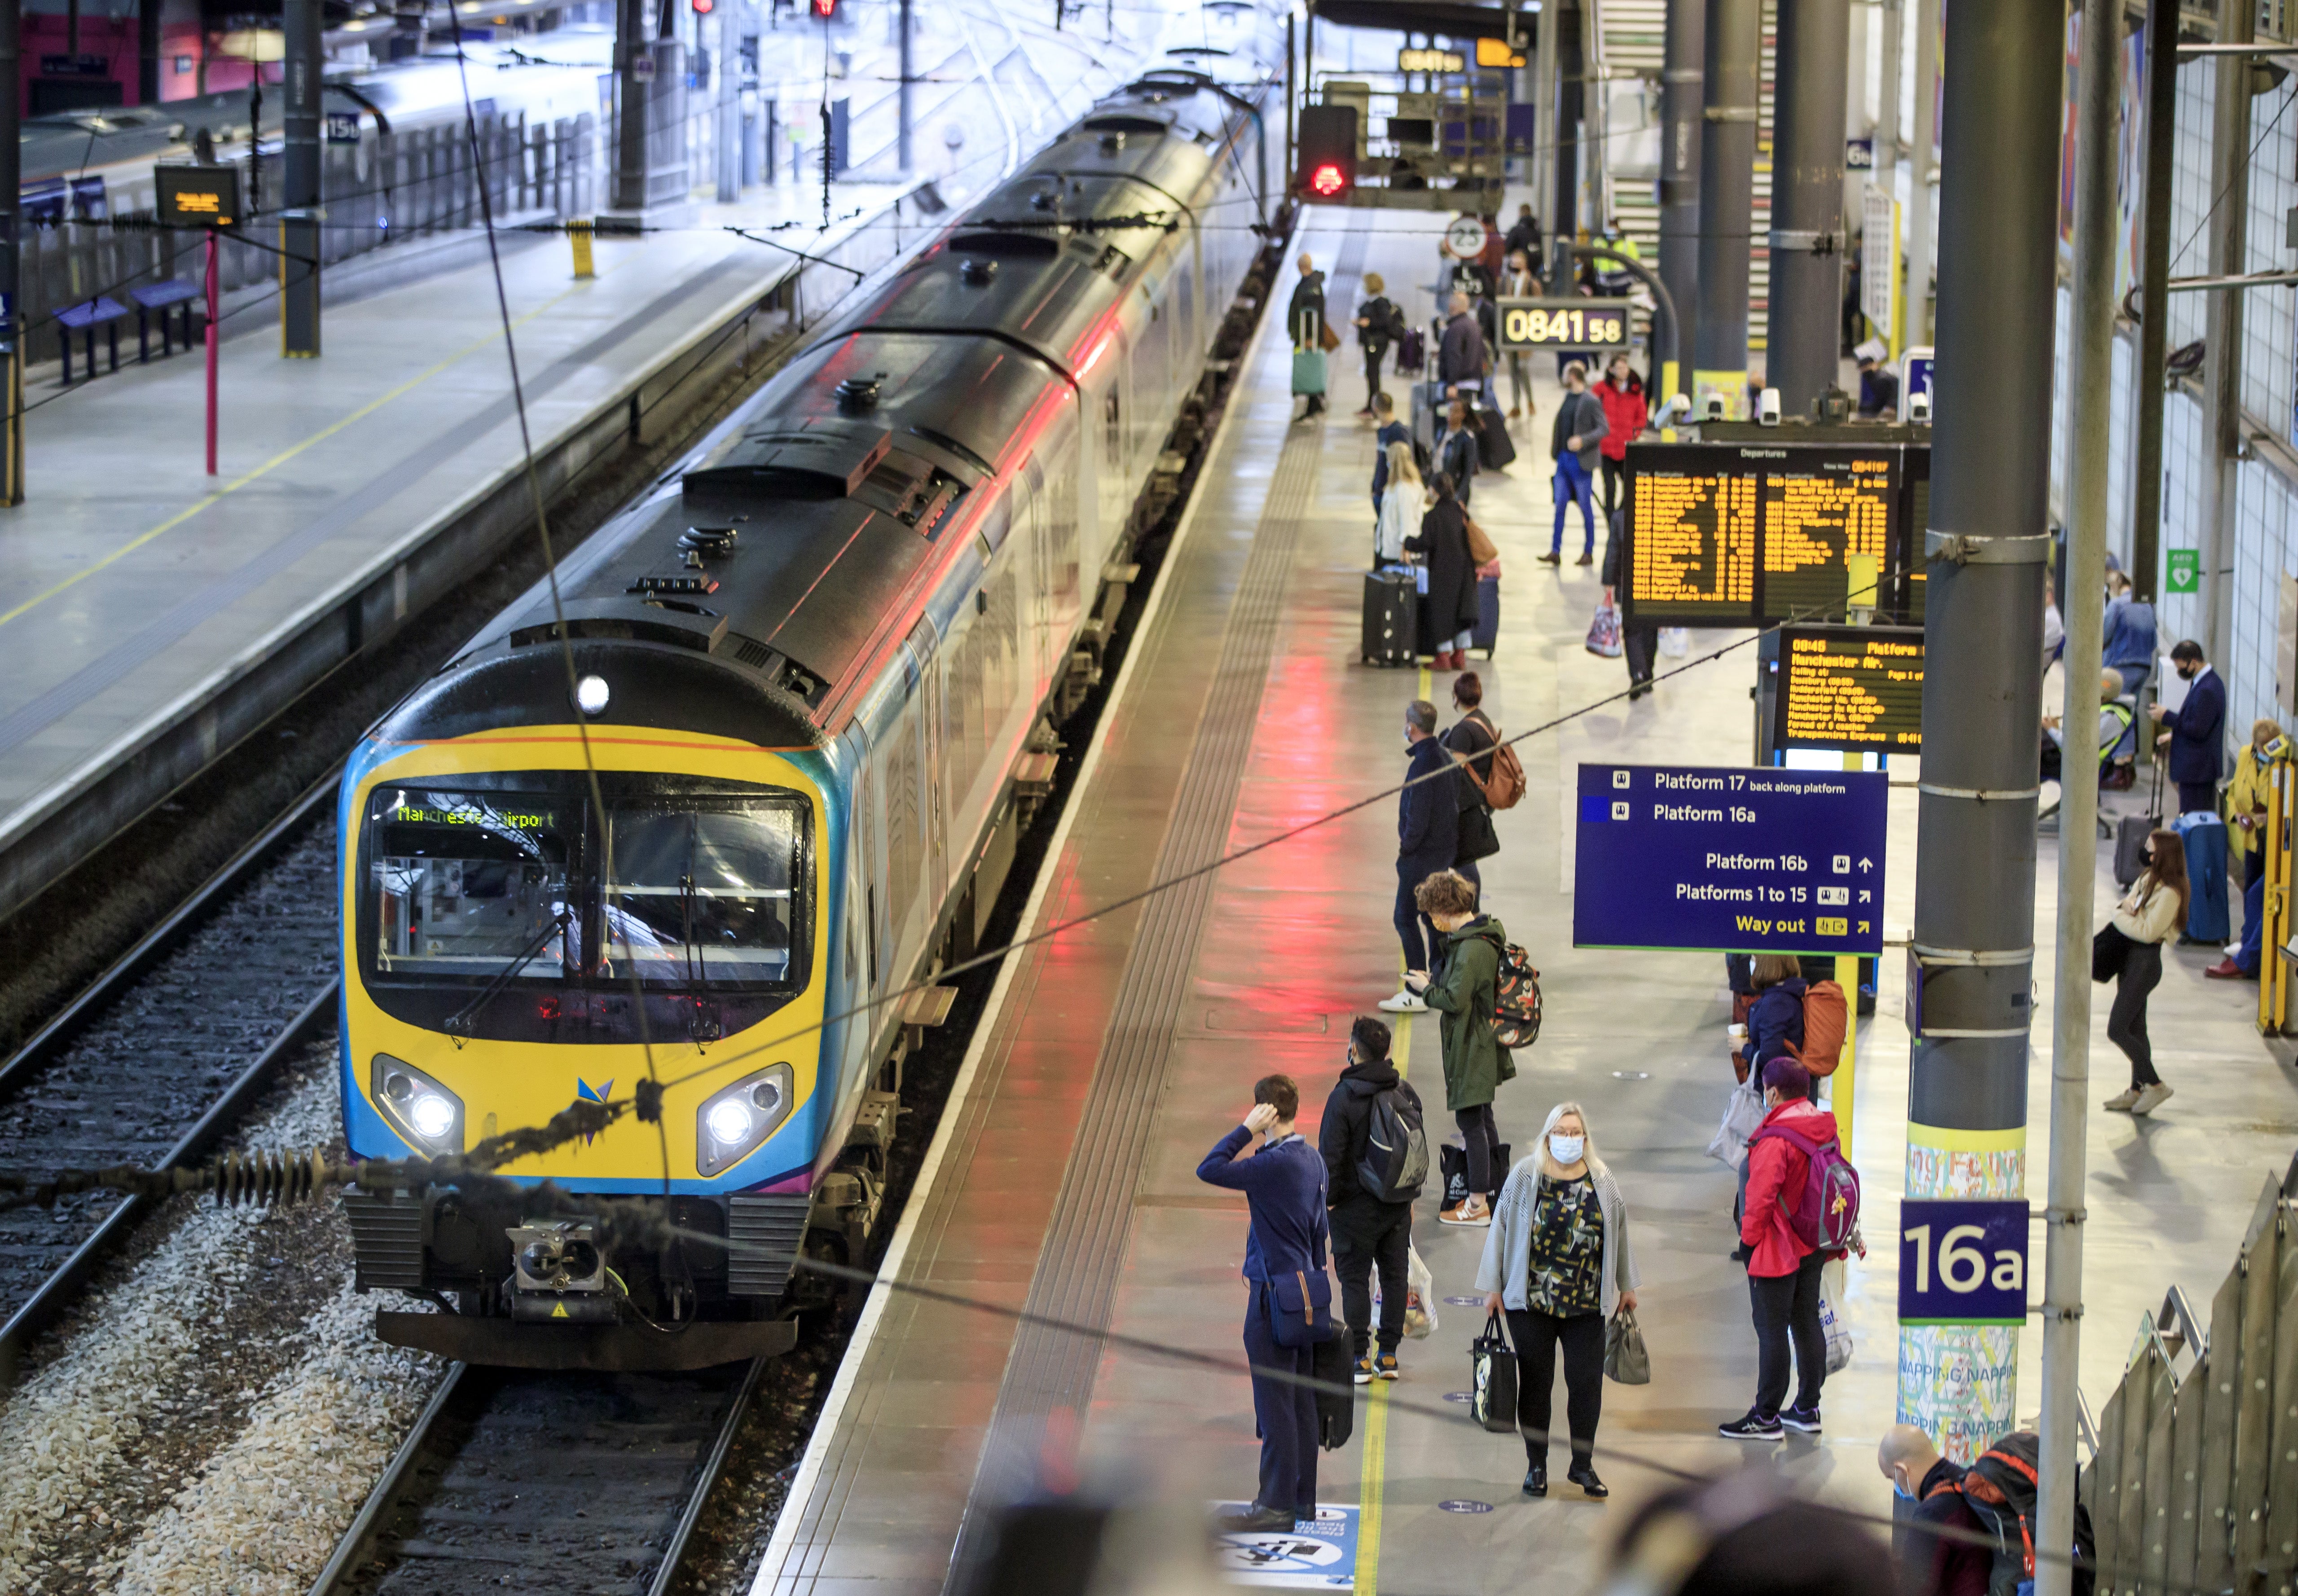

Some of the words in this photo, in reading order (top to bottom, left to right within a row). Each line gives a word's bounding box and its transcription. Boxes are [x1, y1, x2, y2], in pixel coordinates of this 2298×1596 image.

[1506, 308, 1584, 343] 0841
[1589, 318, 1621, 343] 58
[1740, 448, 1787, 460] Departures
[1867, 642, 1917, 656] Platform
[1792, 654, 1859, 668] Manchester
[1863, 656, 1883, 669] Air.
[1655, 773, 1723, 791] Platform
[1729, 775, 1745, 791] 17
[1750, 780, 1773, 792] back
[1775, 781, 1801, 795] along
[1803, 782, 1845, 795] platform
[1654, 804, 1722, 822] Platform
[1729, 806, 1756, 823] 16a
[1706, 853, 1775, 871] Platform
[1780, 855, 1808, 871] 16b
[1676, 884, 1753, 902] Platforms
[1758, 886, 1764, 902] 1
[1768, 888, 1785, 903] to
[1790, 887, 1807, 903] 15
[1736, 916, 1771, 935] Way
[1777, 917, 1806, 933] out
[1904, 1224, 2022, 1293] 16a
[1900, 1360, 1962, 1382] NAPPING
[1967, 1364, 2017, 1382] NAPPIN
[1963, 1419, 2011, 1436] NAPPIN
